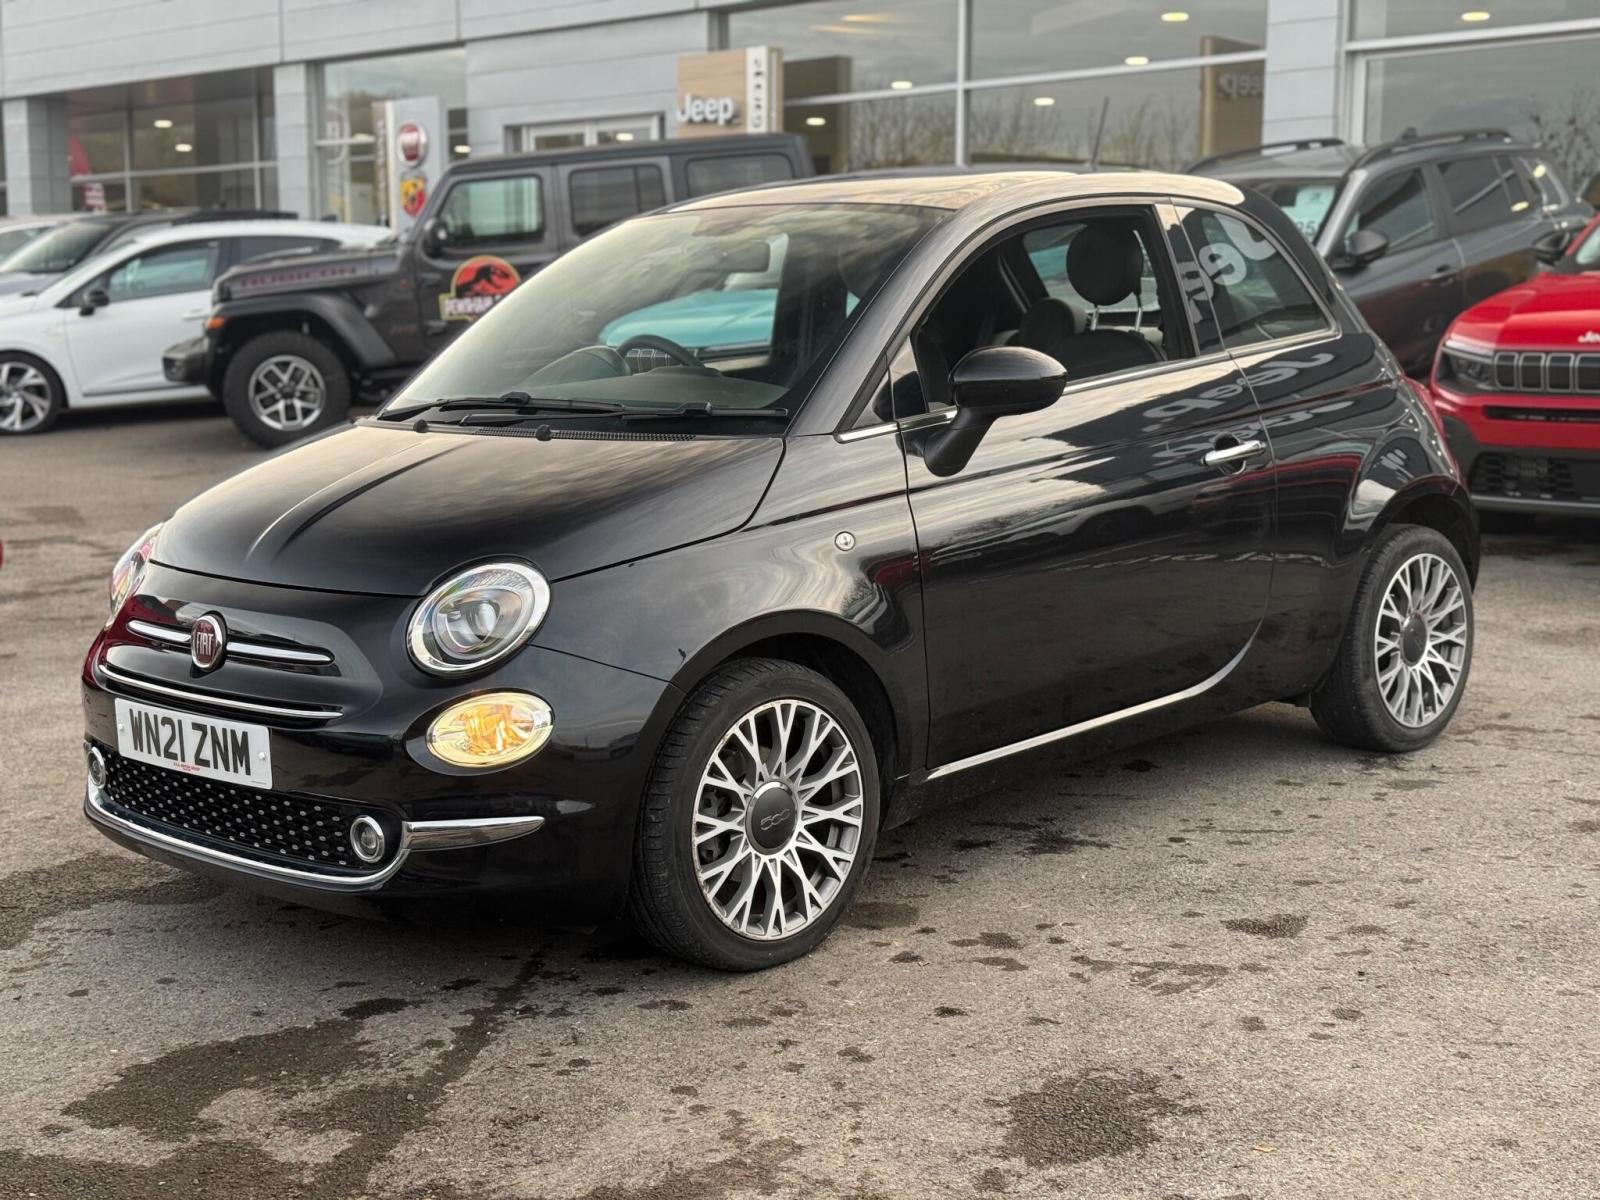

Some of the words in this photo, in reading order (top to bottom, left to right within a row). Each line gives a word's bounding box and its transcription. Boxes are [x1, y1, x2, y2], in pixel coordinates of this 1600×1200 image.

[676, 93, 734, 126] Jeep
[196, 631, 214, 656] FIAT
[129, 708, 186, 763] WN21
[191, 722, 251, 776] ZNM
